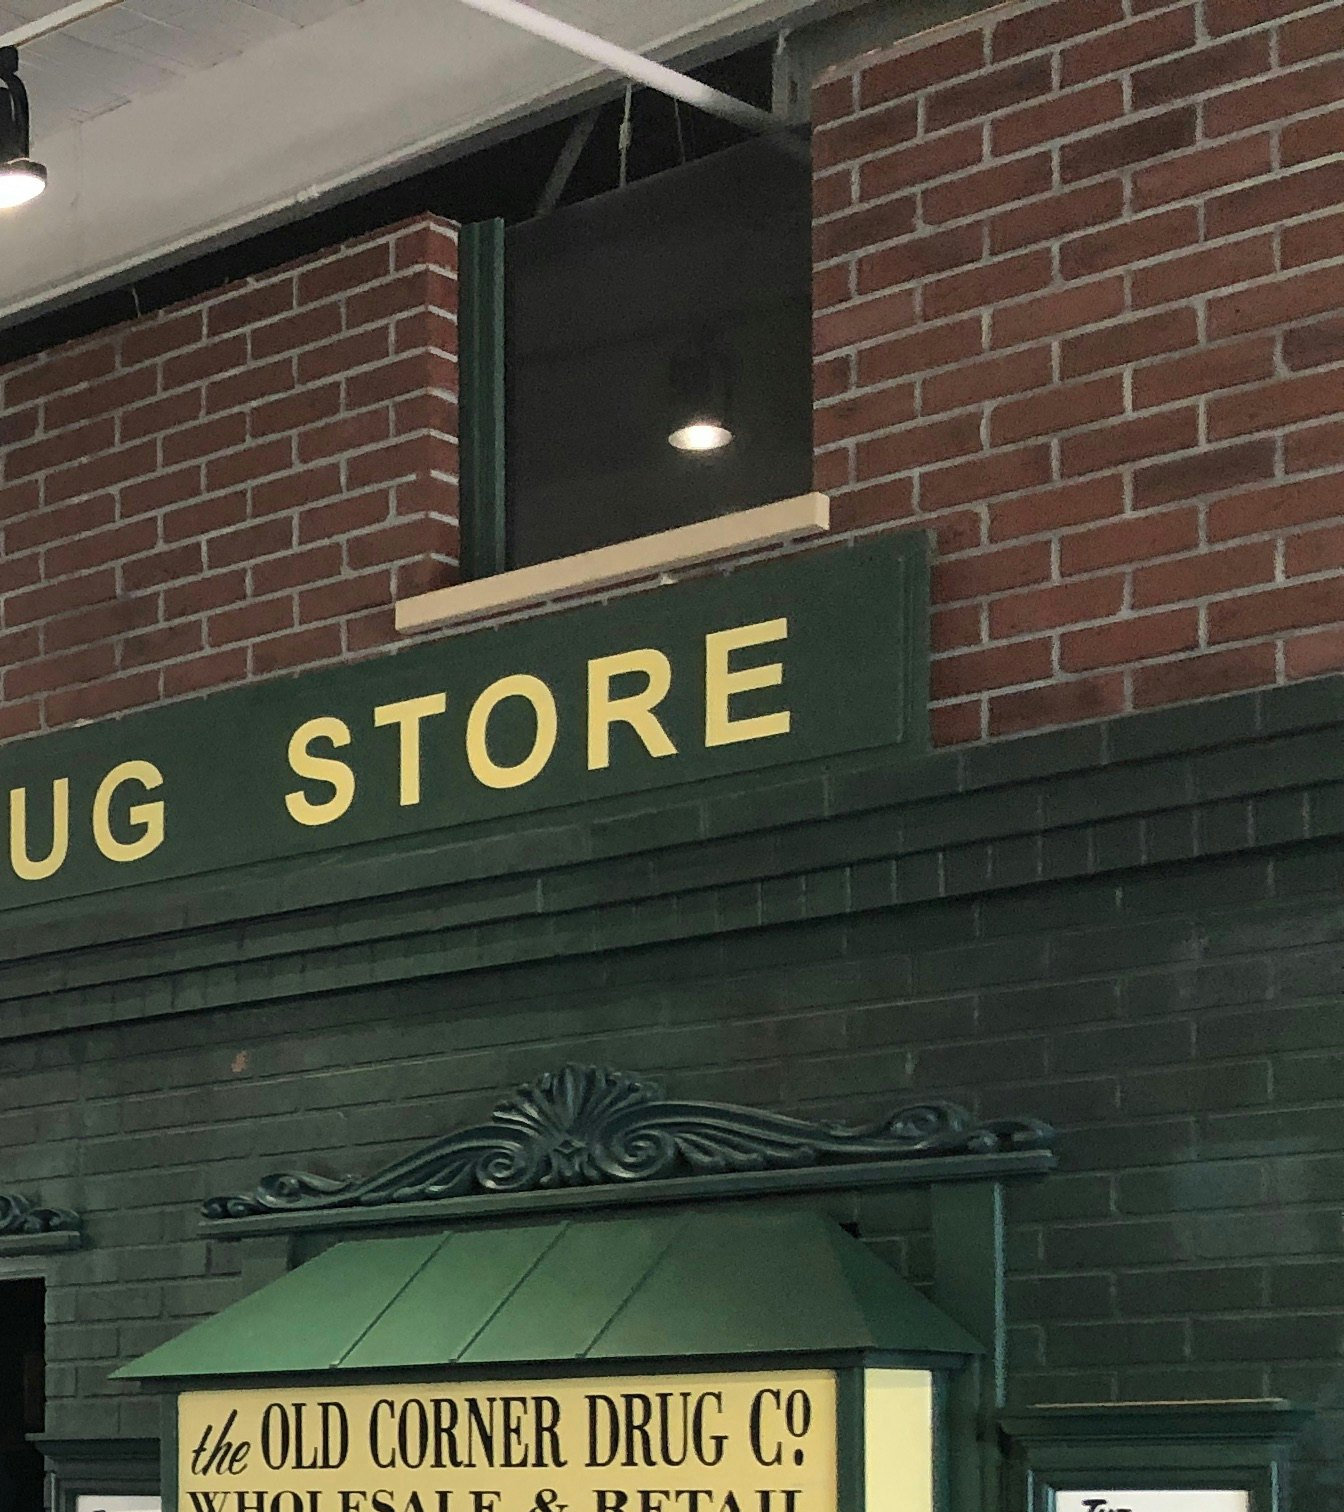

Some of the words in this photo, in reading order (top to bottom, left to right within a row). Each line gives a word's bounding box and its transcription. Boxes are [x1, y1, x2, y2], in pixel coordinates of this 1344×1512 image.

[285, 617, 791, 826] STORE
[191, 1410, 251, 1476] the
[261, 1401, 349, 1471] OLD
[368, 1395, 567, 1469] CORNER
[584, 1391, 728, 1468] DRUG
